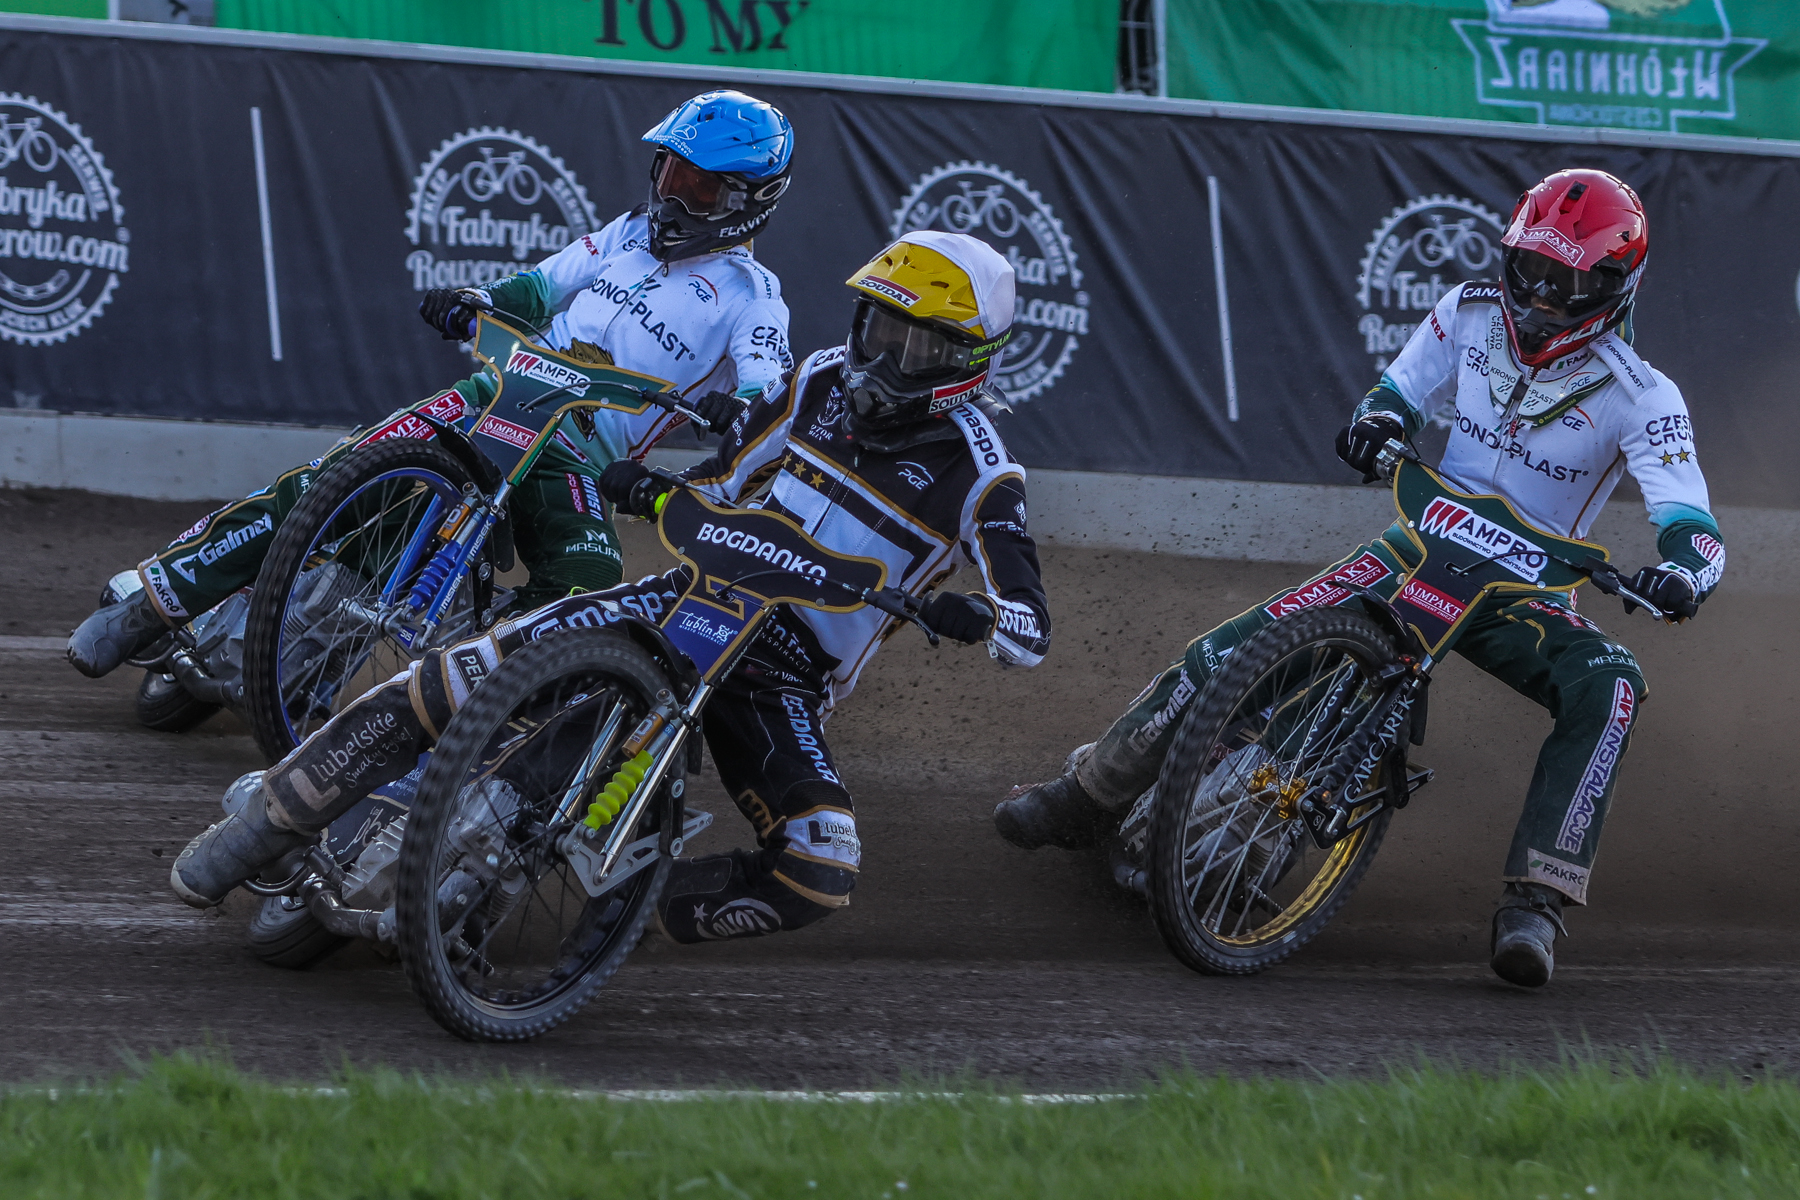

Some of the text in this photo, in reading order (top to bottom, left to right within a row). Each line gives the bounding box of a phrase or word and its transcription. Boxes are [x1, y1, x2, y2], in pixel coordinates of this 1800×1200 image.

[441, 206, 569, 260] Fabryka
[1527, 231, 1579, 255] IMPAKT
[688, 280, 713, 303] PGE
[857, 278, 911, 307] SOUDAL
[1462, 287, 1503, 299] CANA
[1489, 366, 1517, 383] KRONO
[1605, 343, 1646, 390] KRONO-PLAST
[1570, 375, 1591, 392] PGE
[379, 394, 457, 441] IMPKT
[492, 422, 534, 443] IMPAKT
[1559, 414, 1586, 432] GE
[1454, 408, 1582, 484] RONO-PLAST
[897, 471, 929, 491] PGE
[696, 522, 828, 587] BOGDANKA
[151, 575, 180, 613] FAKRO
[1293, 558, 1375, 606] IMPAKT
[1414, 586, 1463, 617] IMPAKT
[760, 631, 811, 674] NSPIRACJI
[460, 654, 487, 690] PER
